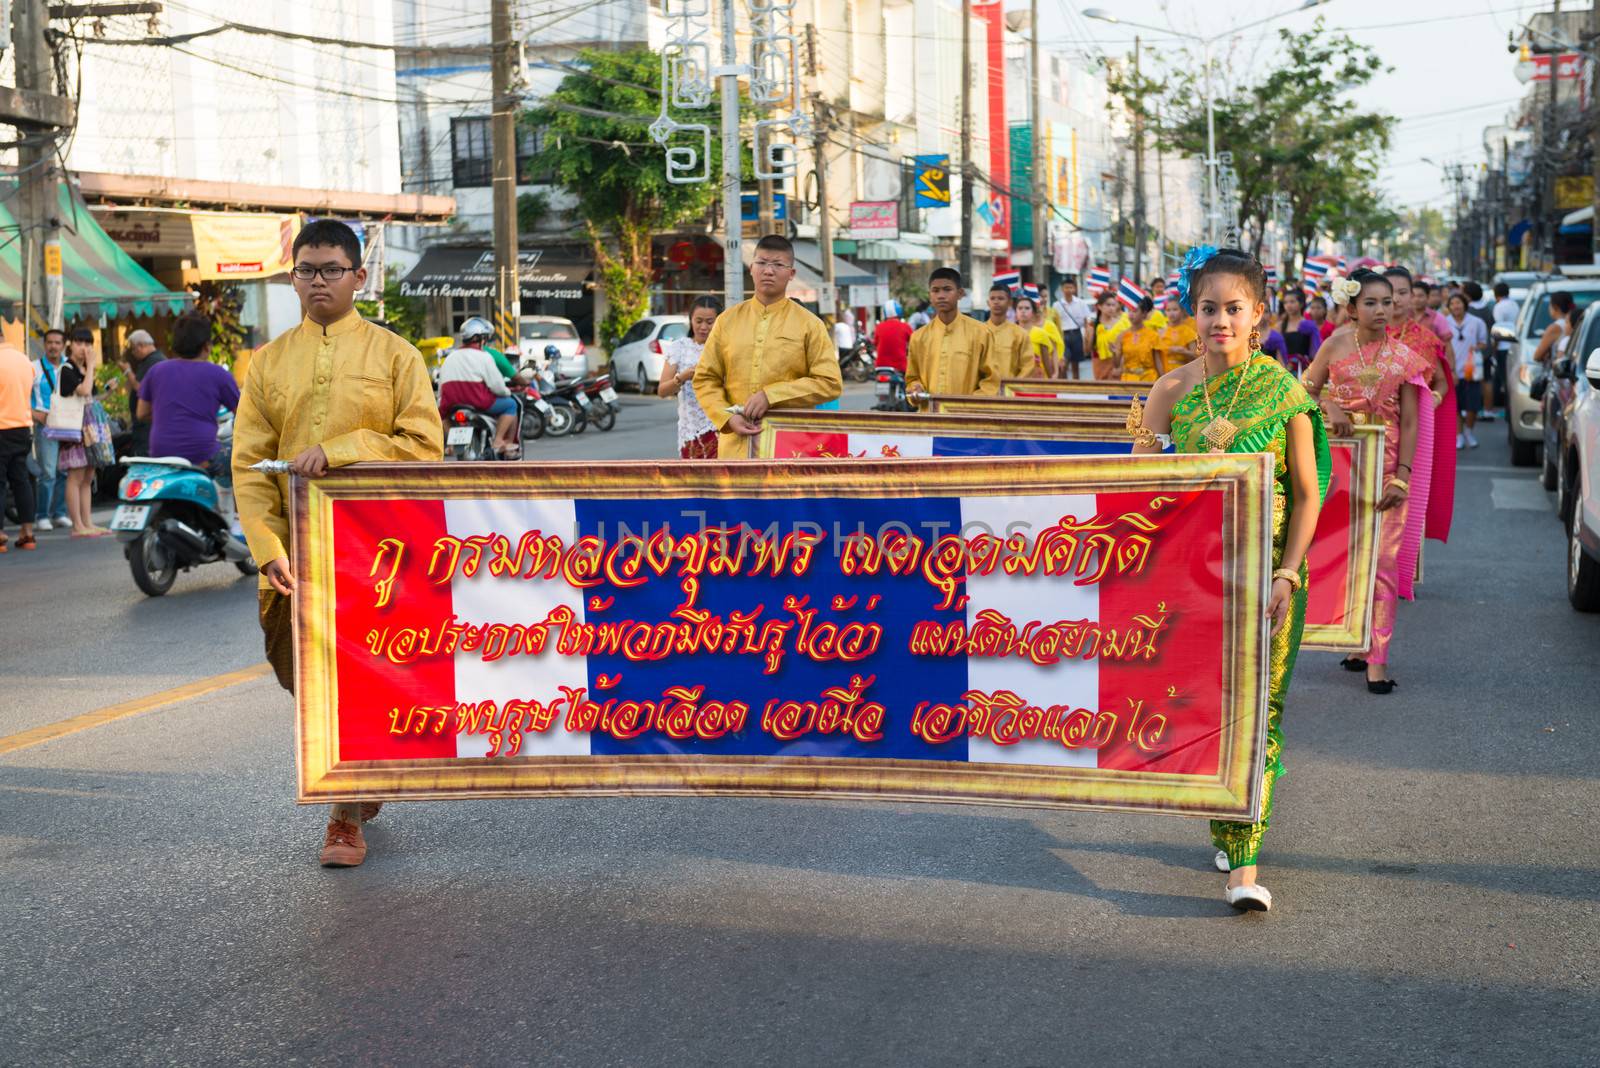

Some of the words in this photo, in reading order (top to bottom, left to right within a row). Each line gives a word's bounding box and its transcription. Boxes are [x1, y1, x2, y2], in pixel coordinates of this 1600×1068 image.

[369, 536, 406, 609] กู
[426, 524, 827, 609] กรมหลวงชุมพร
[760, 674, 886, 741] เอาเนื้อ
